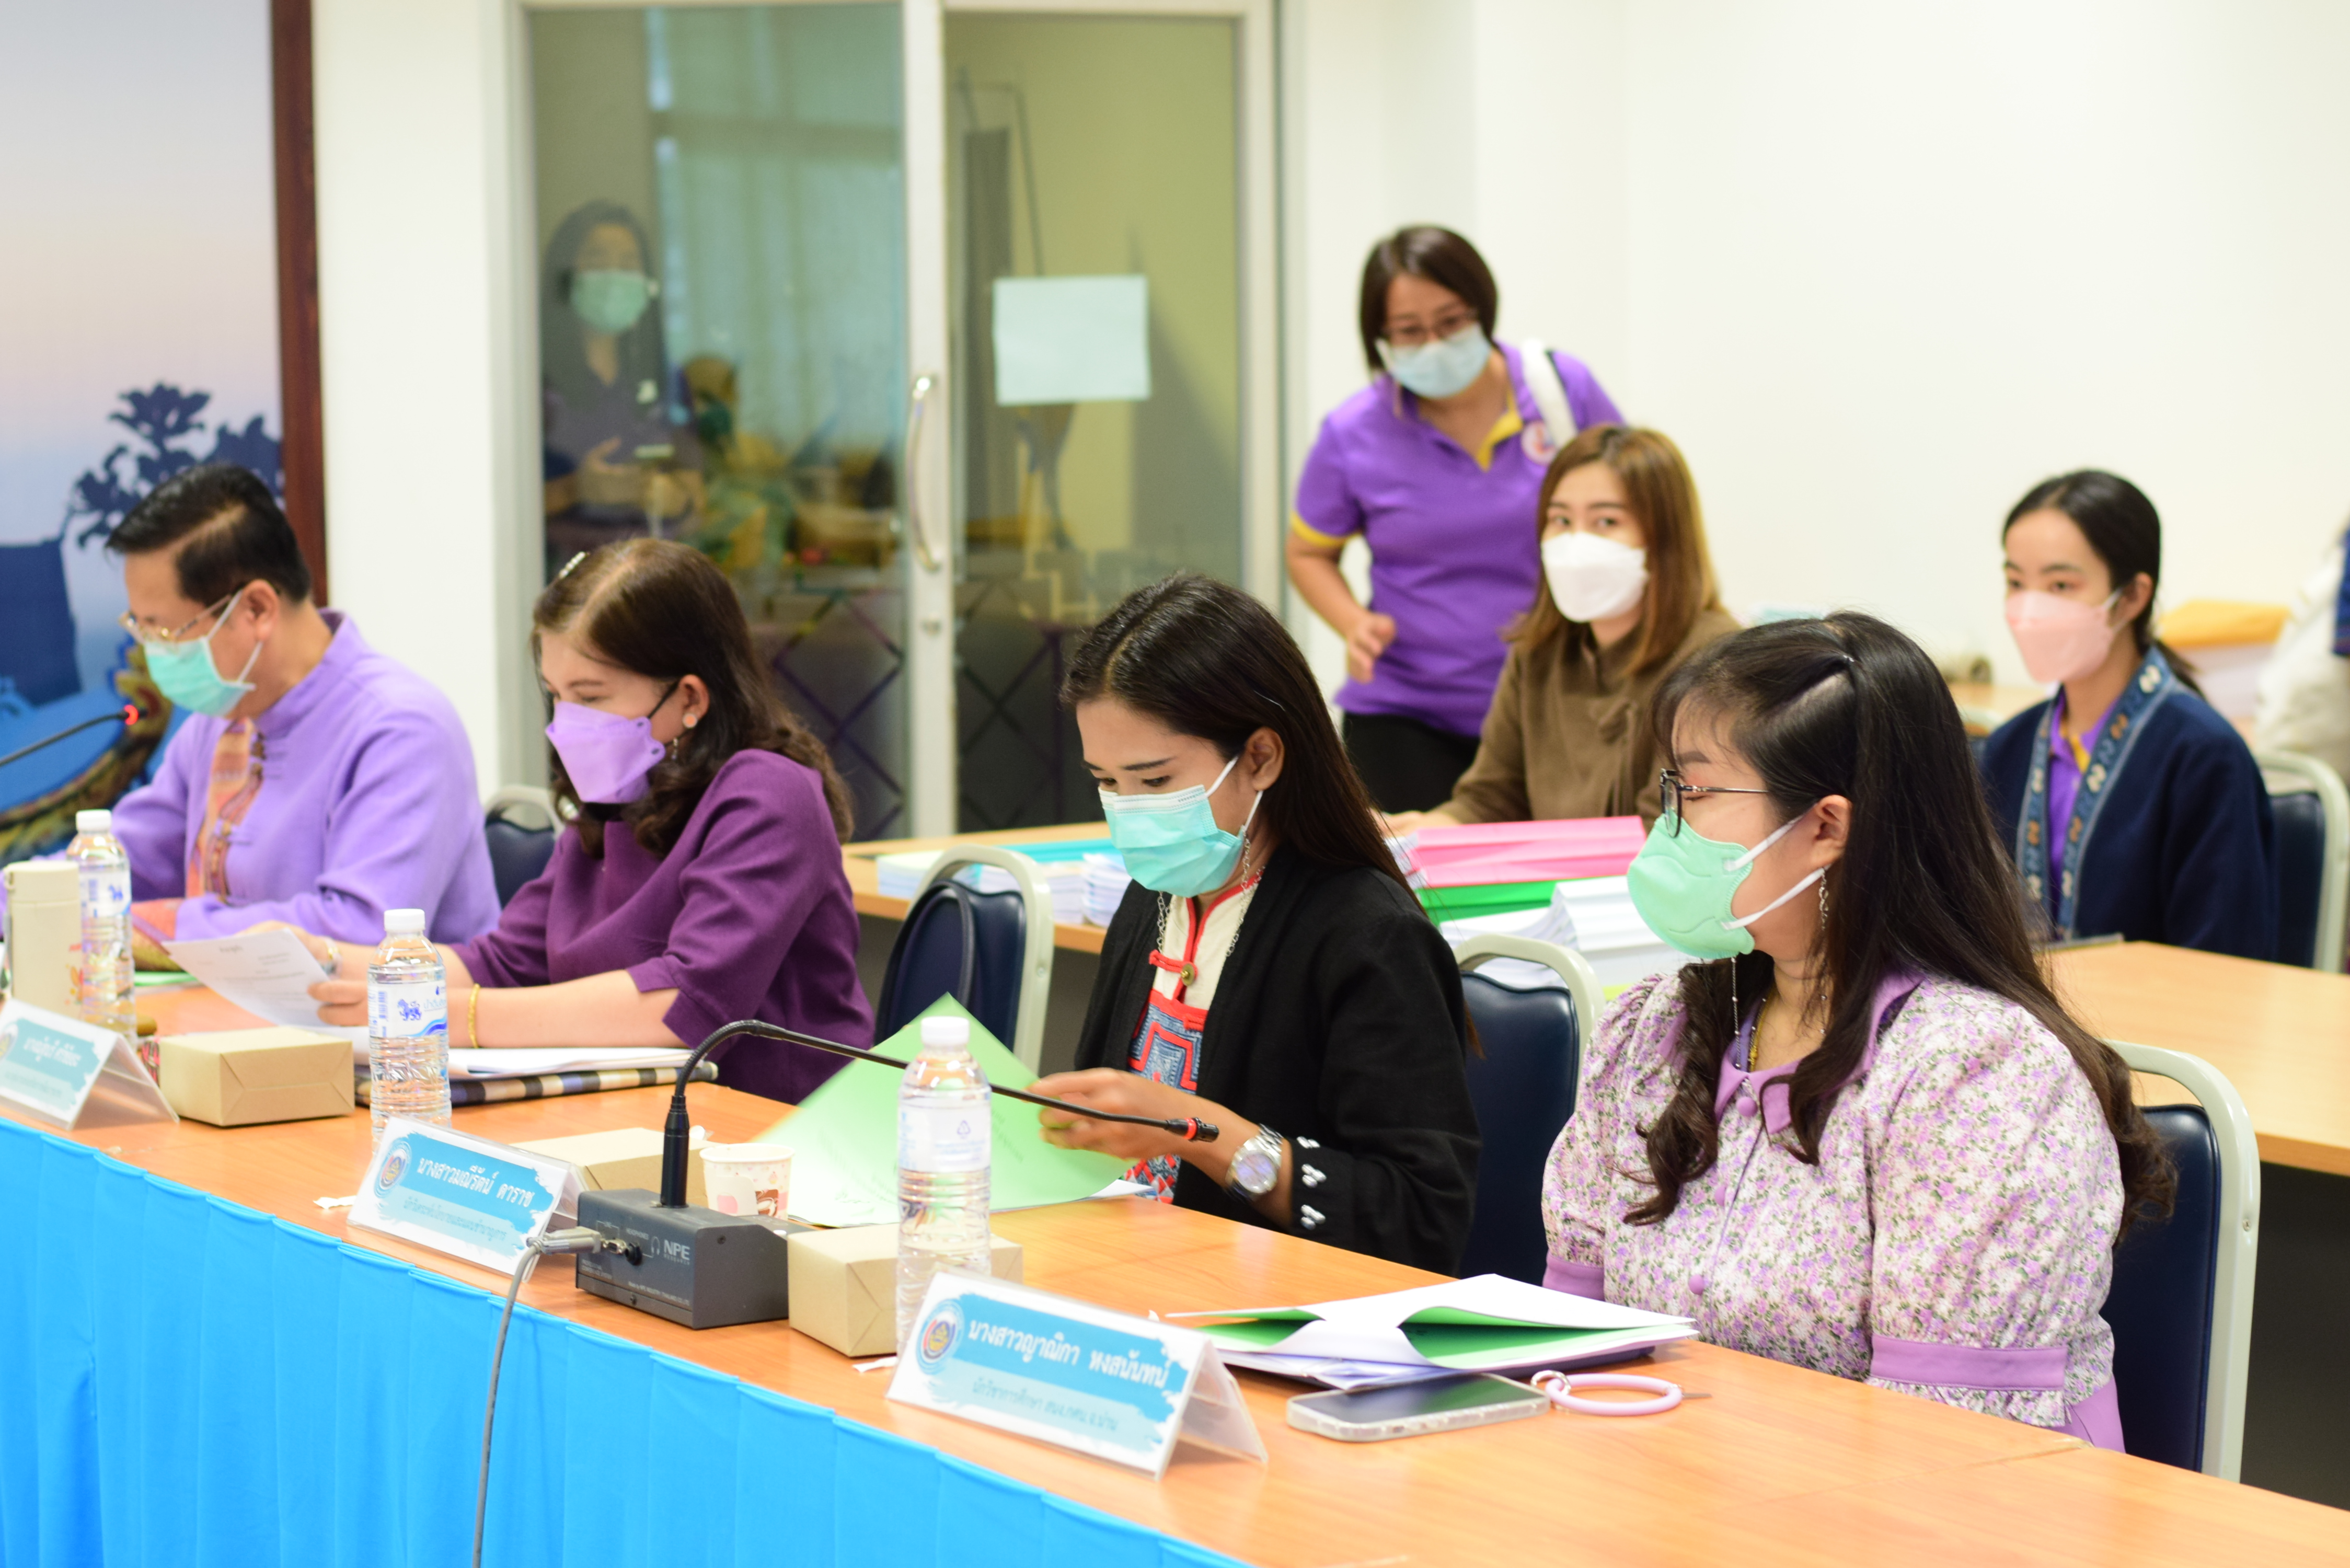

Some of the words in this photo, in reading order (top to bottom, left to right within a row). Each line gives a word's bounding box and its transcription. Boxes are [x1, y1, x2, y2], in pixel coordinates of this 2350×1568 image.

[417, 1158, 499, 1195] นางสาวมณีรัตน์
[663, 1239, 690, 1260] NPE
[969, 1320, 1080, 1365] นางสาวญาณิกา
